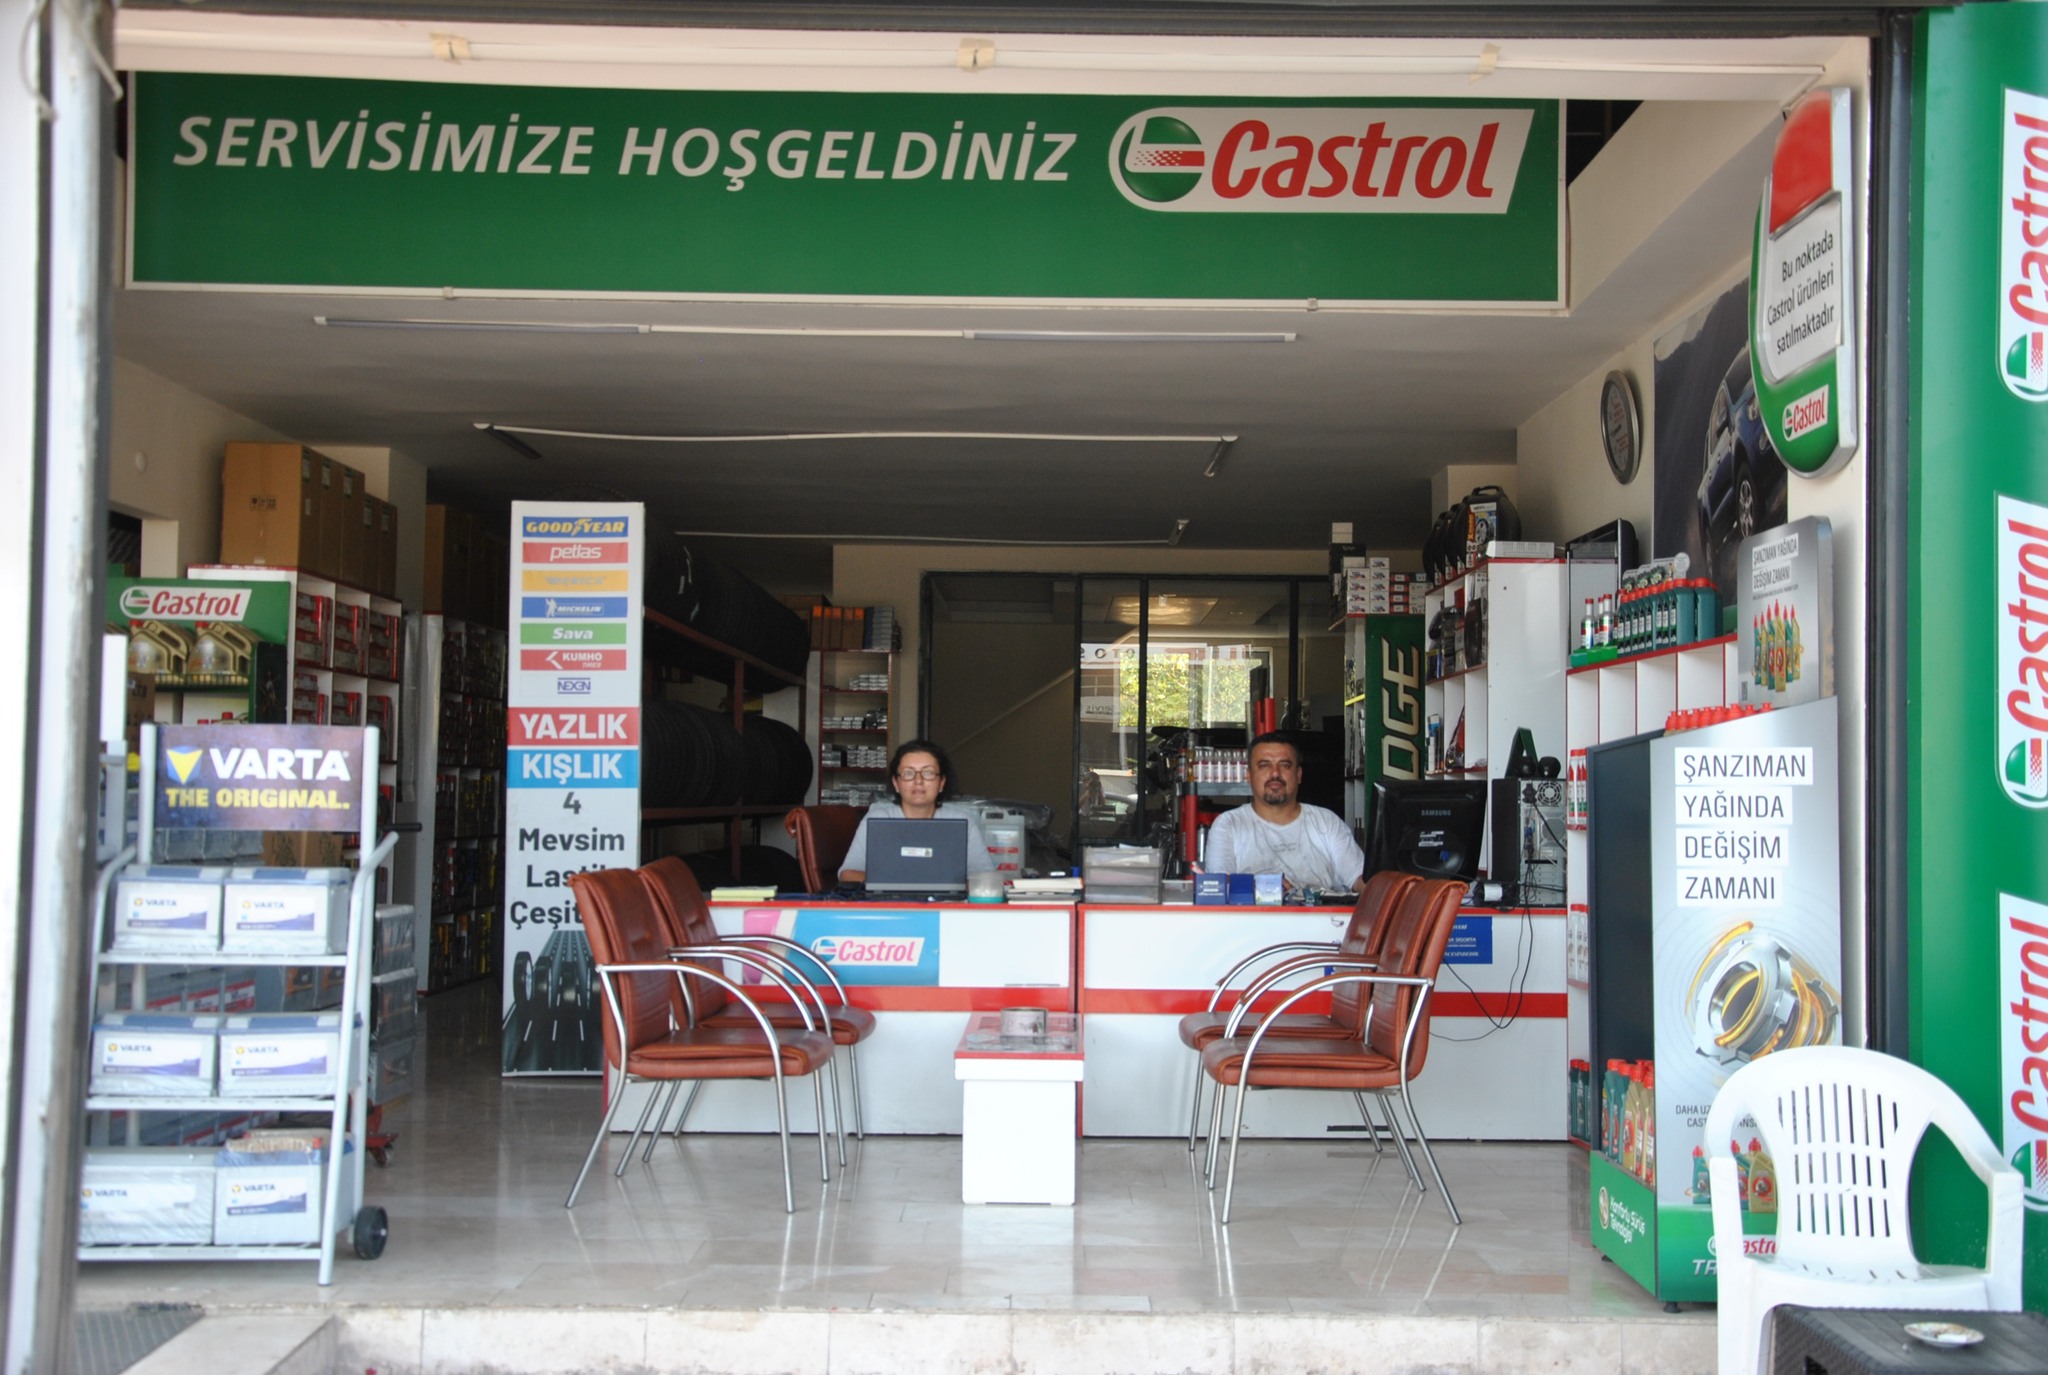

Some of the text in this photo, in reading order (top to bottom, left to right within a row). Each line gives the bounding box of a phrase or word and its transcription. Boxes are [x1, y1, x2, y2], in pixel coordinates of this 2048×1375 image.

[173, 109, 1078, 192] SERVİSİMİZE HOŞGELDİNİZ
[1211, 119, 1500, 199] Castrol
[2009, 112, 2048, 326] Castrol
[1782, 231, 1834, 282] Bu noktada
[1767, 264, 1834, 326] Castrol ürünleri
[1776, 304, 1835, 355] satılmaktadır
[1792, 391, 1826, 434] Castrol
[526, 518, 625, 537] GOODYEAR
[152, 591, 241, 616] Castrol
[557, 605, 602, 613] MICHELIN
[552, 628, 594, 640] Sava
[2007, 518, 2048, 733] Castrol
[562, 652, 603, 662] KUMHO
[557, 680, 591, 692] NEXEN
[519, 713, 628, 740] YAZLIK
[209, 748, 351, 781] VARTA
[522, 753, 623, 785] KIŞLIK
[1683, 754, 1805, 783] ŞANZIMAN
[165, 788, 351, 810] THE ORIGINAL.
[562, 791, 582, 815] 4
[1683, 789, 1785, 819] YAĞINDA
[1421, 809, 1452, 817] SAMSUNG
[518, 827, 625, 852] Mevsim
[1684, 830, 1781, 866] DEĞİŞİM
[1684, 876, 1776, 900] ZAMANI
[510, 900, 584, 930] Çeşit
[838, 940, 917, 963] Castrol
[2008, 916, 2048, 1134] Castrol
[1675, 1104, 1712, 1115] DAHA UZ
[1686, 1117, 1708, 1128] CAST
[1743, 1237, 1776, 1255] astr
